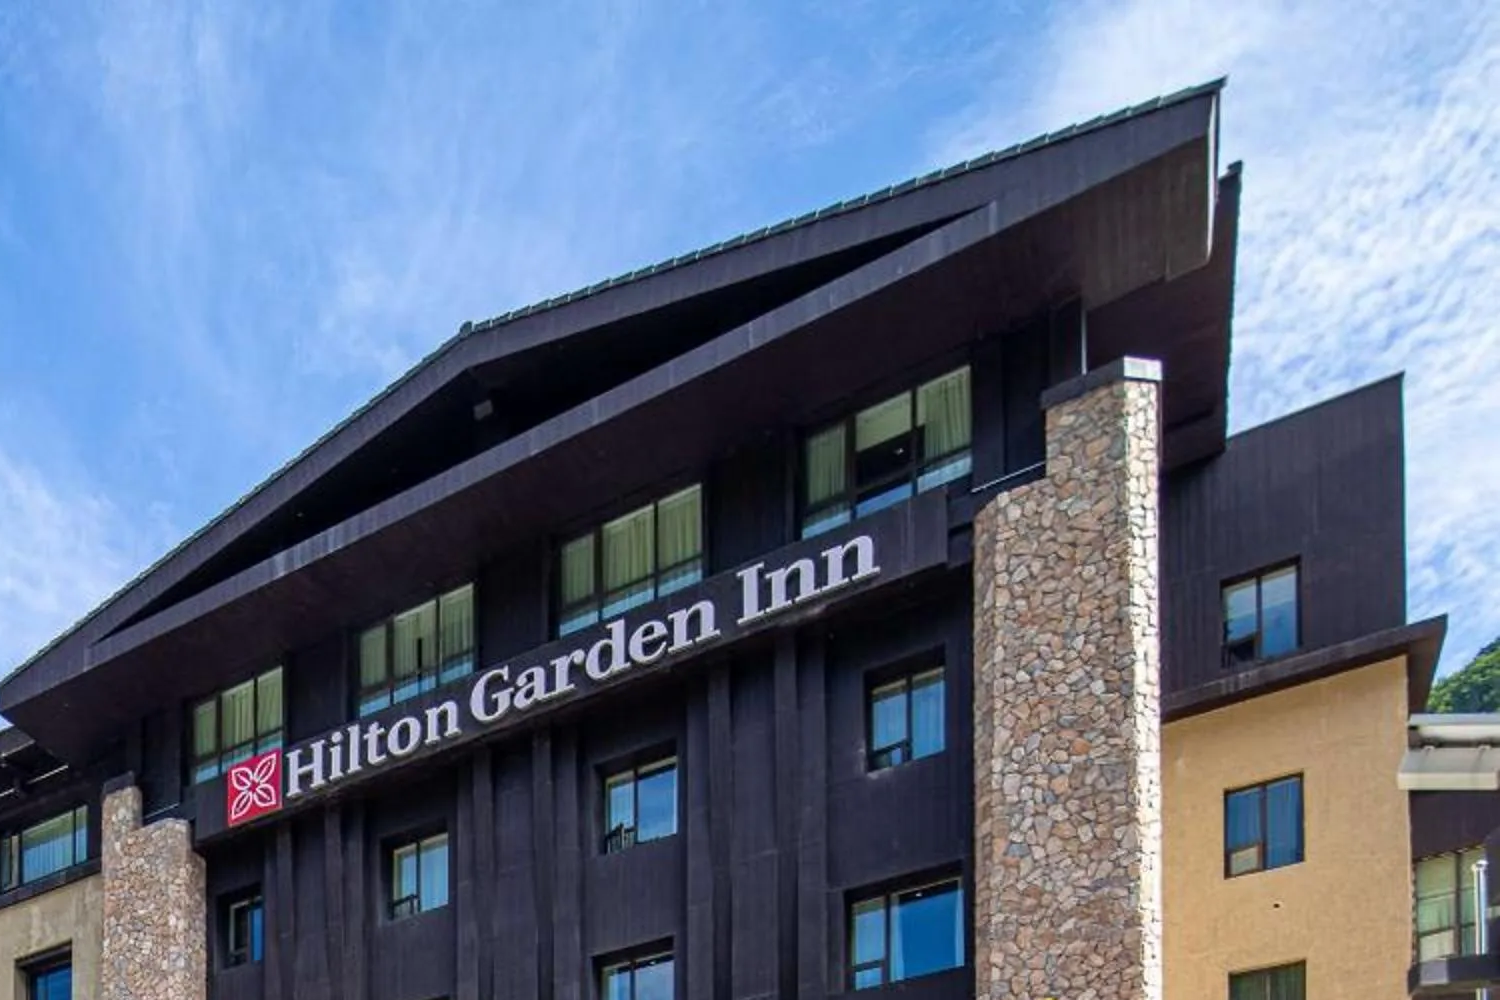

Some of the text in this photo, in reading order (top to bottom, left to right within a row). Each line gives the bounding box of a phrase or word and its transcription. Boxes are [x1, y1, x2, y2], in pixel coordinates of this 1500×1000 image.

[284, 534, 881, 798] Hilton Garden Inn
